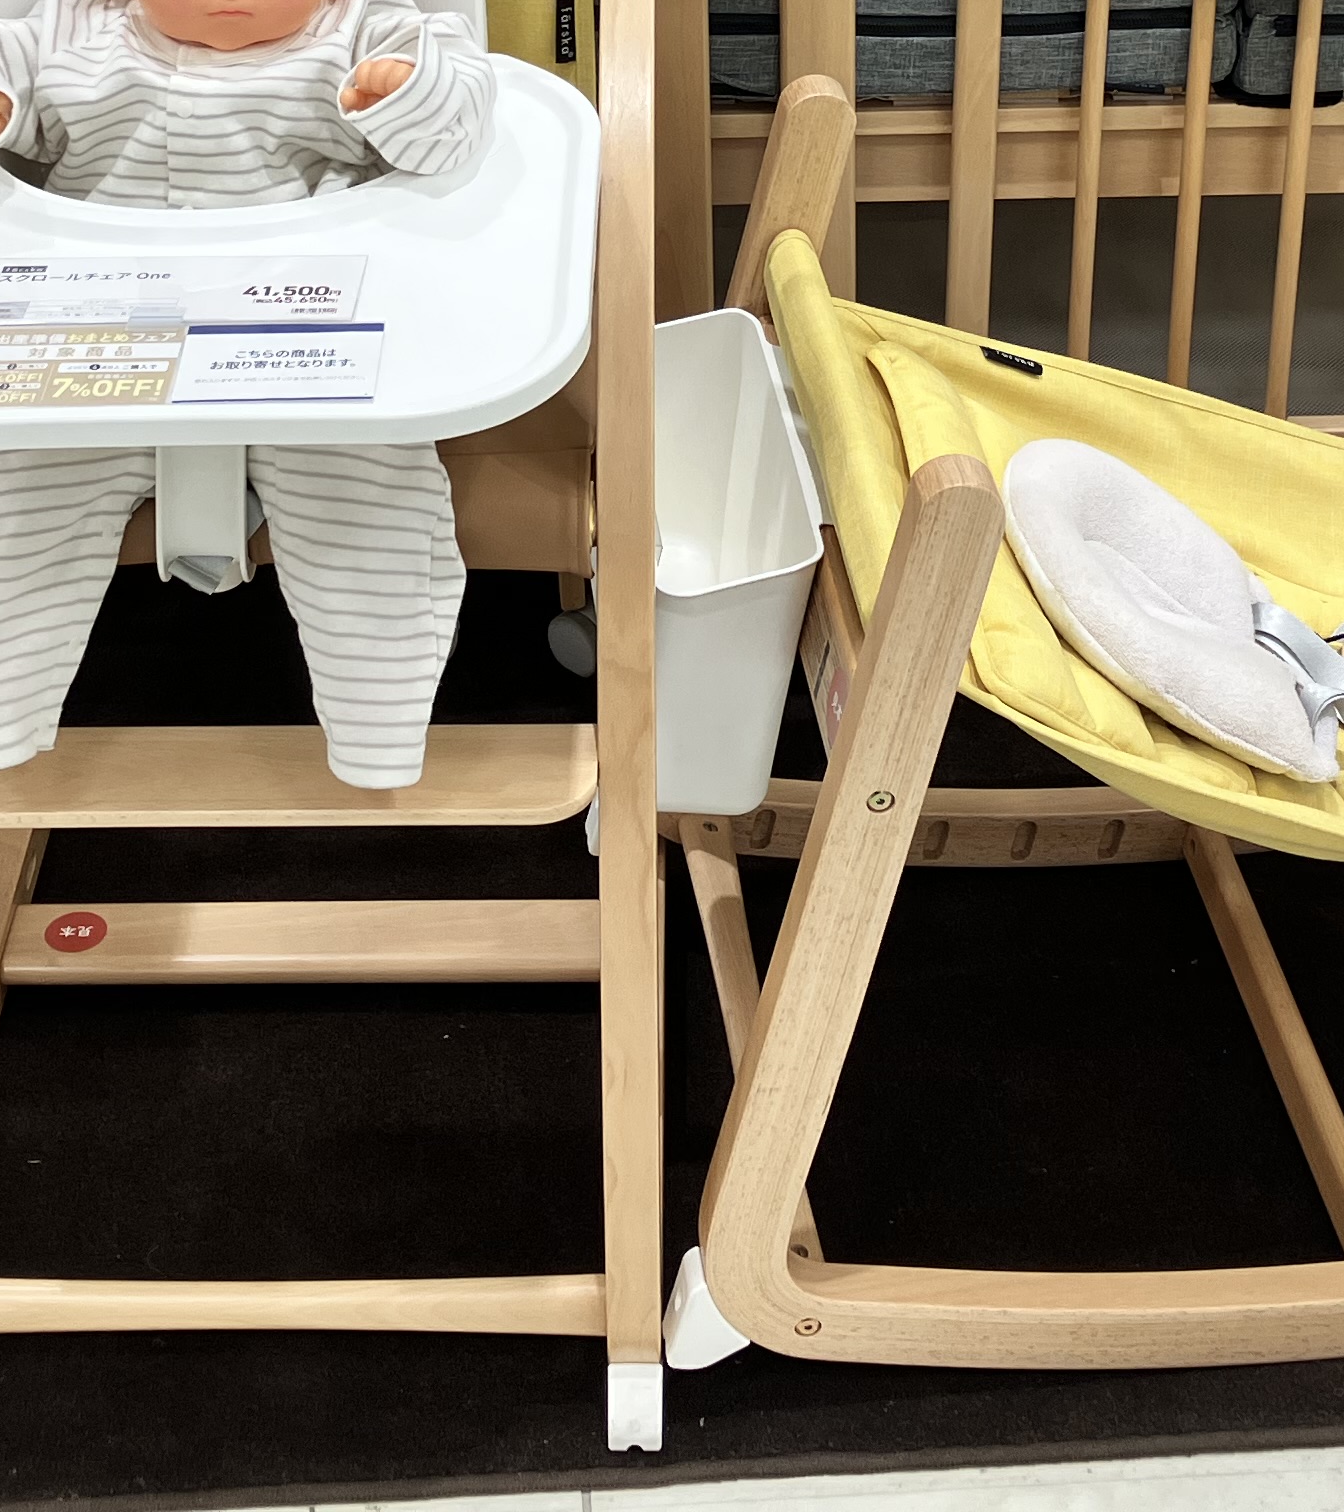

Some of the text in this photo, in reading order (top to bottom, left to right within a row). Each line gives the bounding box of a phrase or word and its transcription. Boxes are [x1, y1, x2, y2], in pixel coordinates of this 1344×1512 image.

[560, 6, 573, 56] färska
[136, 272, 172, 280] One
[242, 285, 342, 297] 41,500円
[27, 346, 134, 358] 対象商品
[234, 348, 337, 358] こちらの商品は
[209, 358, 357, 370] お取り寄せとなります。
[50, 377, 165, 398] 7%OFF!
[59, 925, 94, 938] 見本
